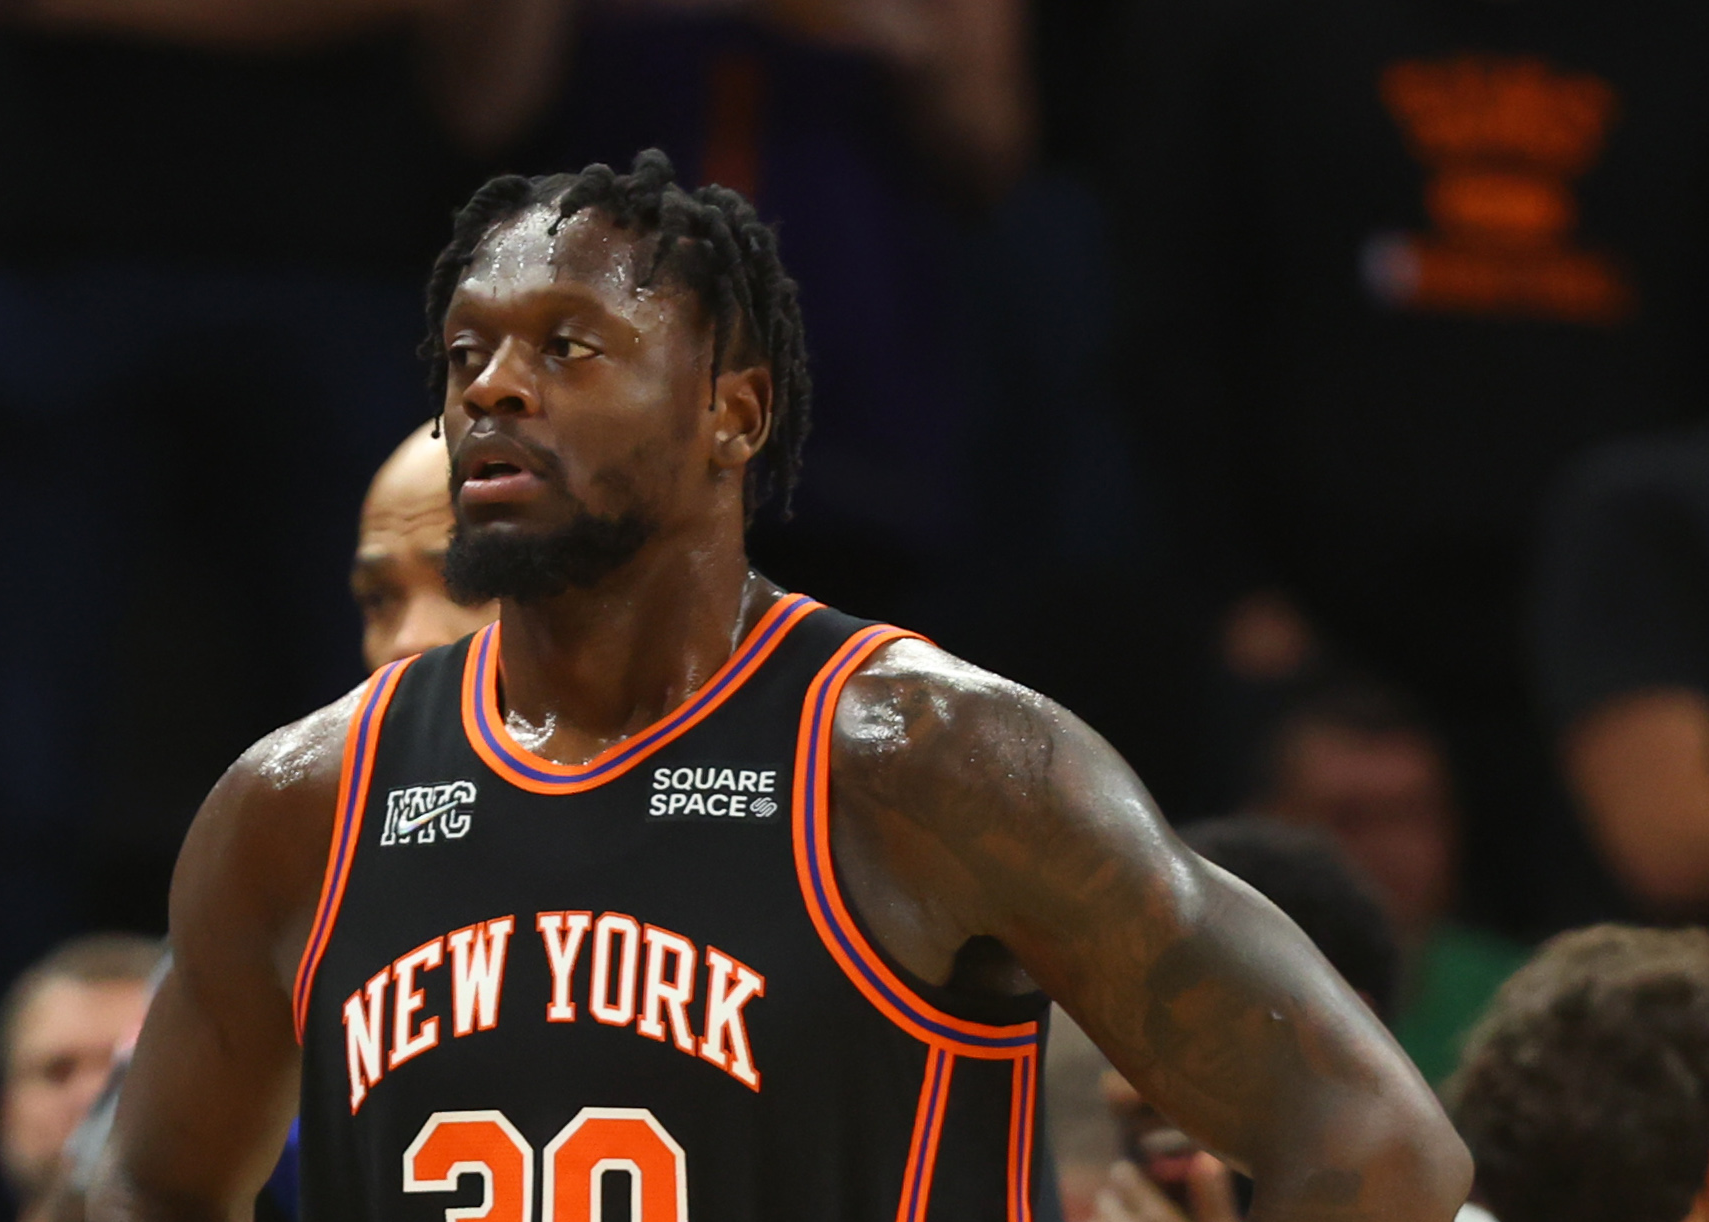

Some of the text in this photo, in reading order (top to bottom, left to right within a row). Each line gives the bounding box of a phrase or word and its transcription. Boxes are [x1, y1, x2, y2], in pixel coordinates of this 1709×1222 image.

[652, 767, 777, 793] SQUARE
[380, 780, 477, 846] NYC
[649, 793, 748, 817] SPACE
[342, 910, 765, 1116] NEW YORK
